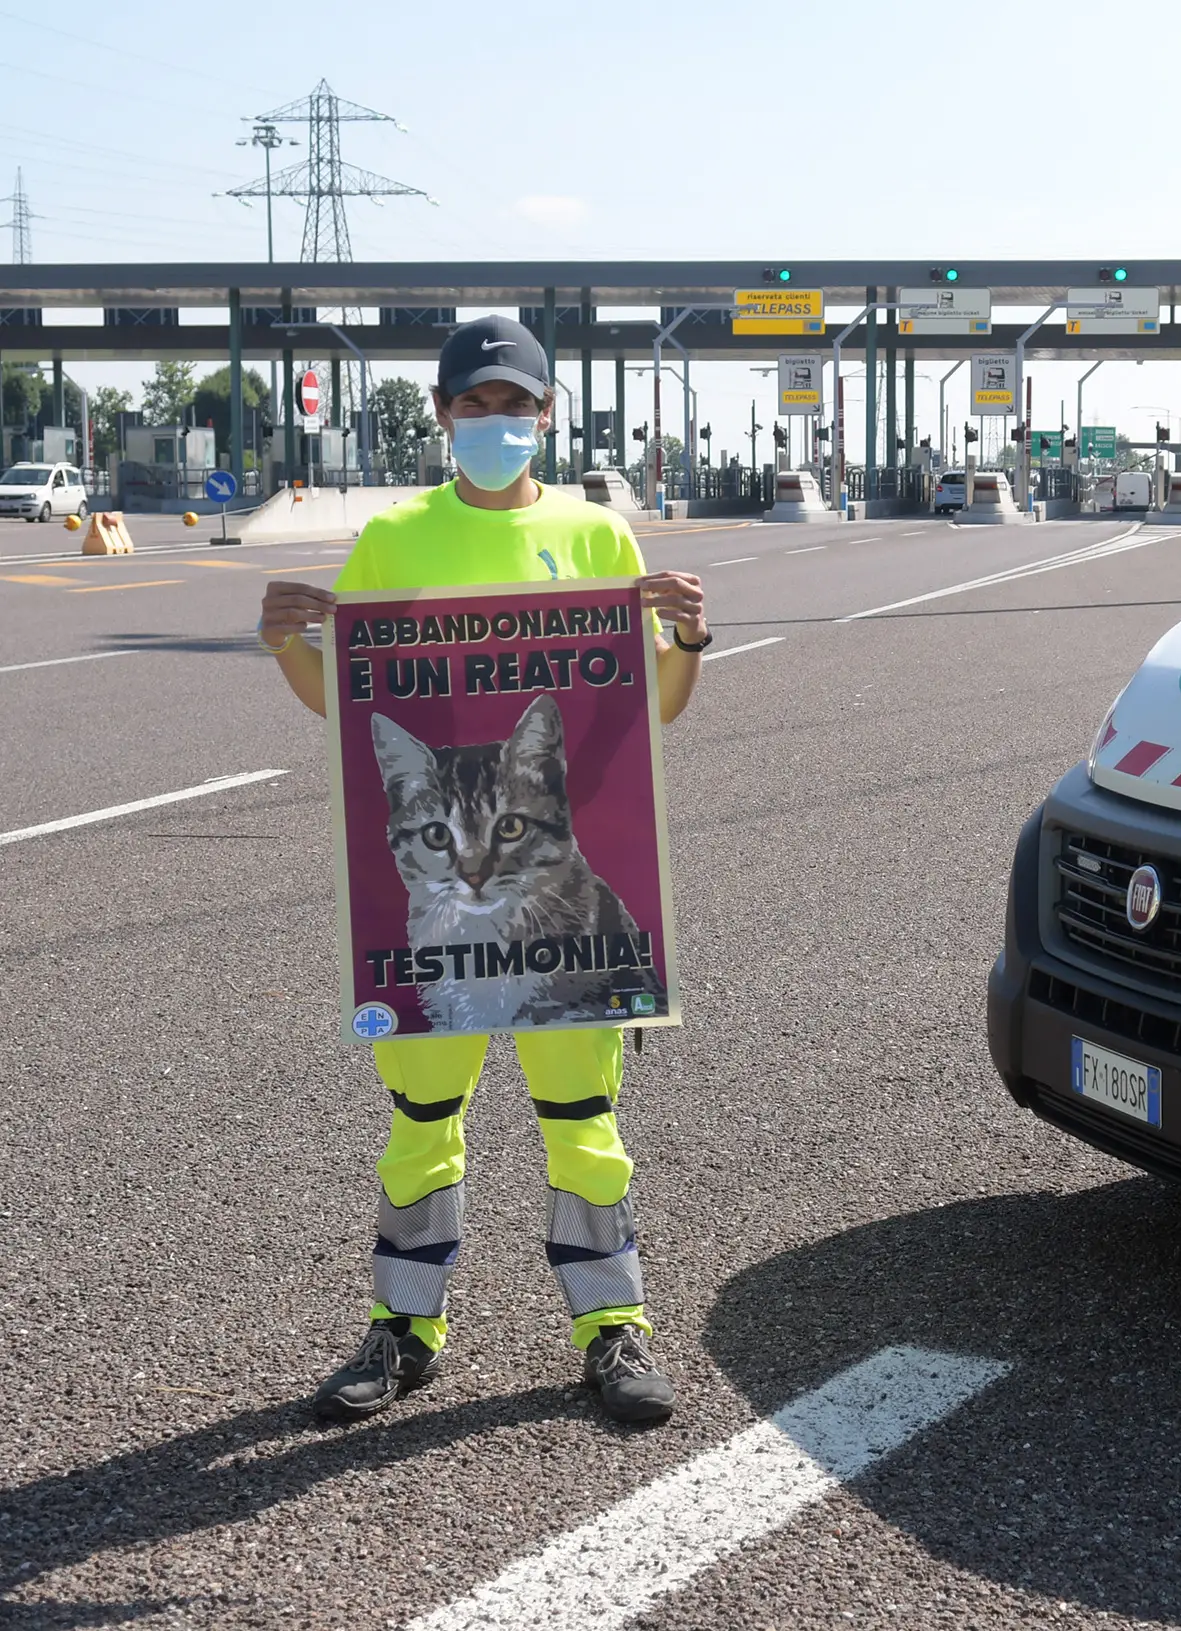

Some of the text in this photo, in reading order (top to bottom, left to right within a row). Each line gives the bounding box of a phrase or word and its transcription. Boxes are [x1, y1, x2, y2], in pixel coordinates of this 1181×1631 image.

[349, 605, 631, 649] ABBANDONARMI
[386, 656, 452, 699] UN
[464, 647, 634, 695] REATO.
[1132, 884, 1153, 913] FIAT
[366, 931, 653, 987] TESTIMONIA!
[605, 1008, 628, 1016] anas
